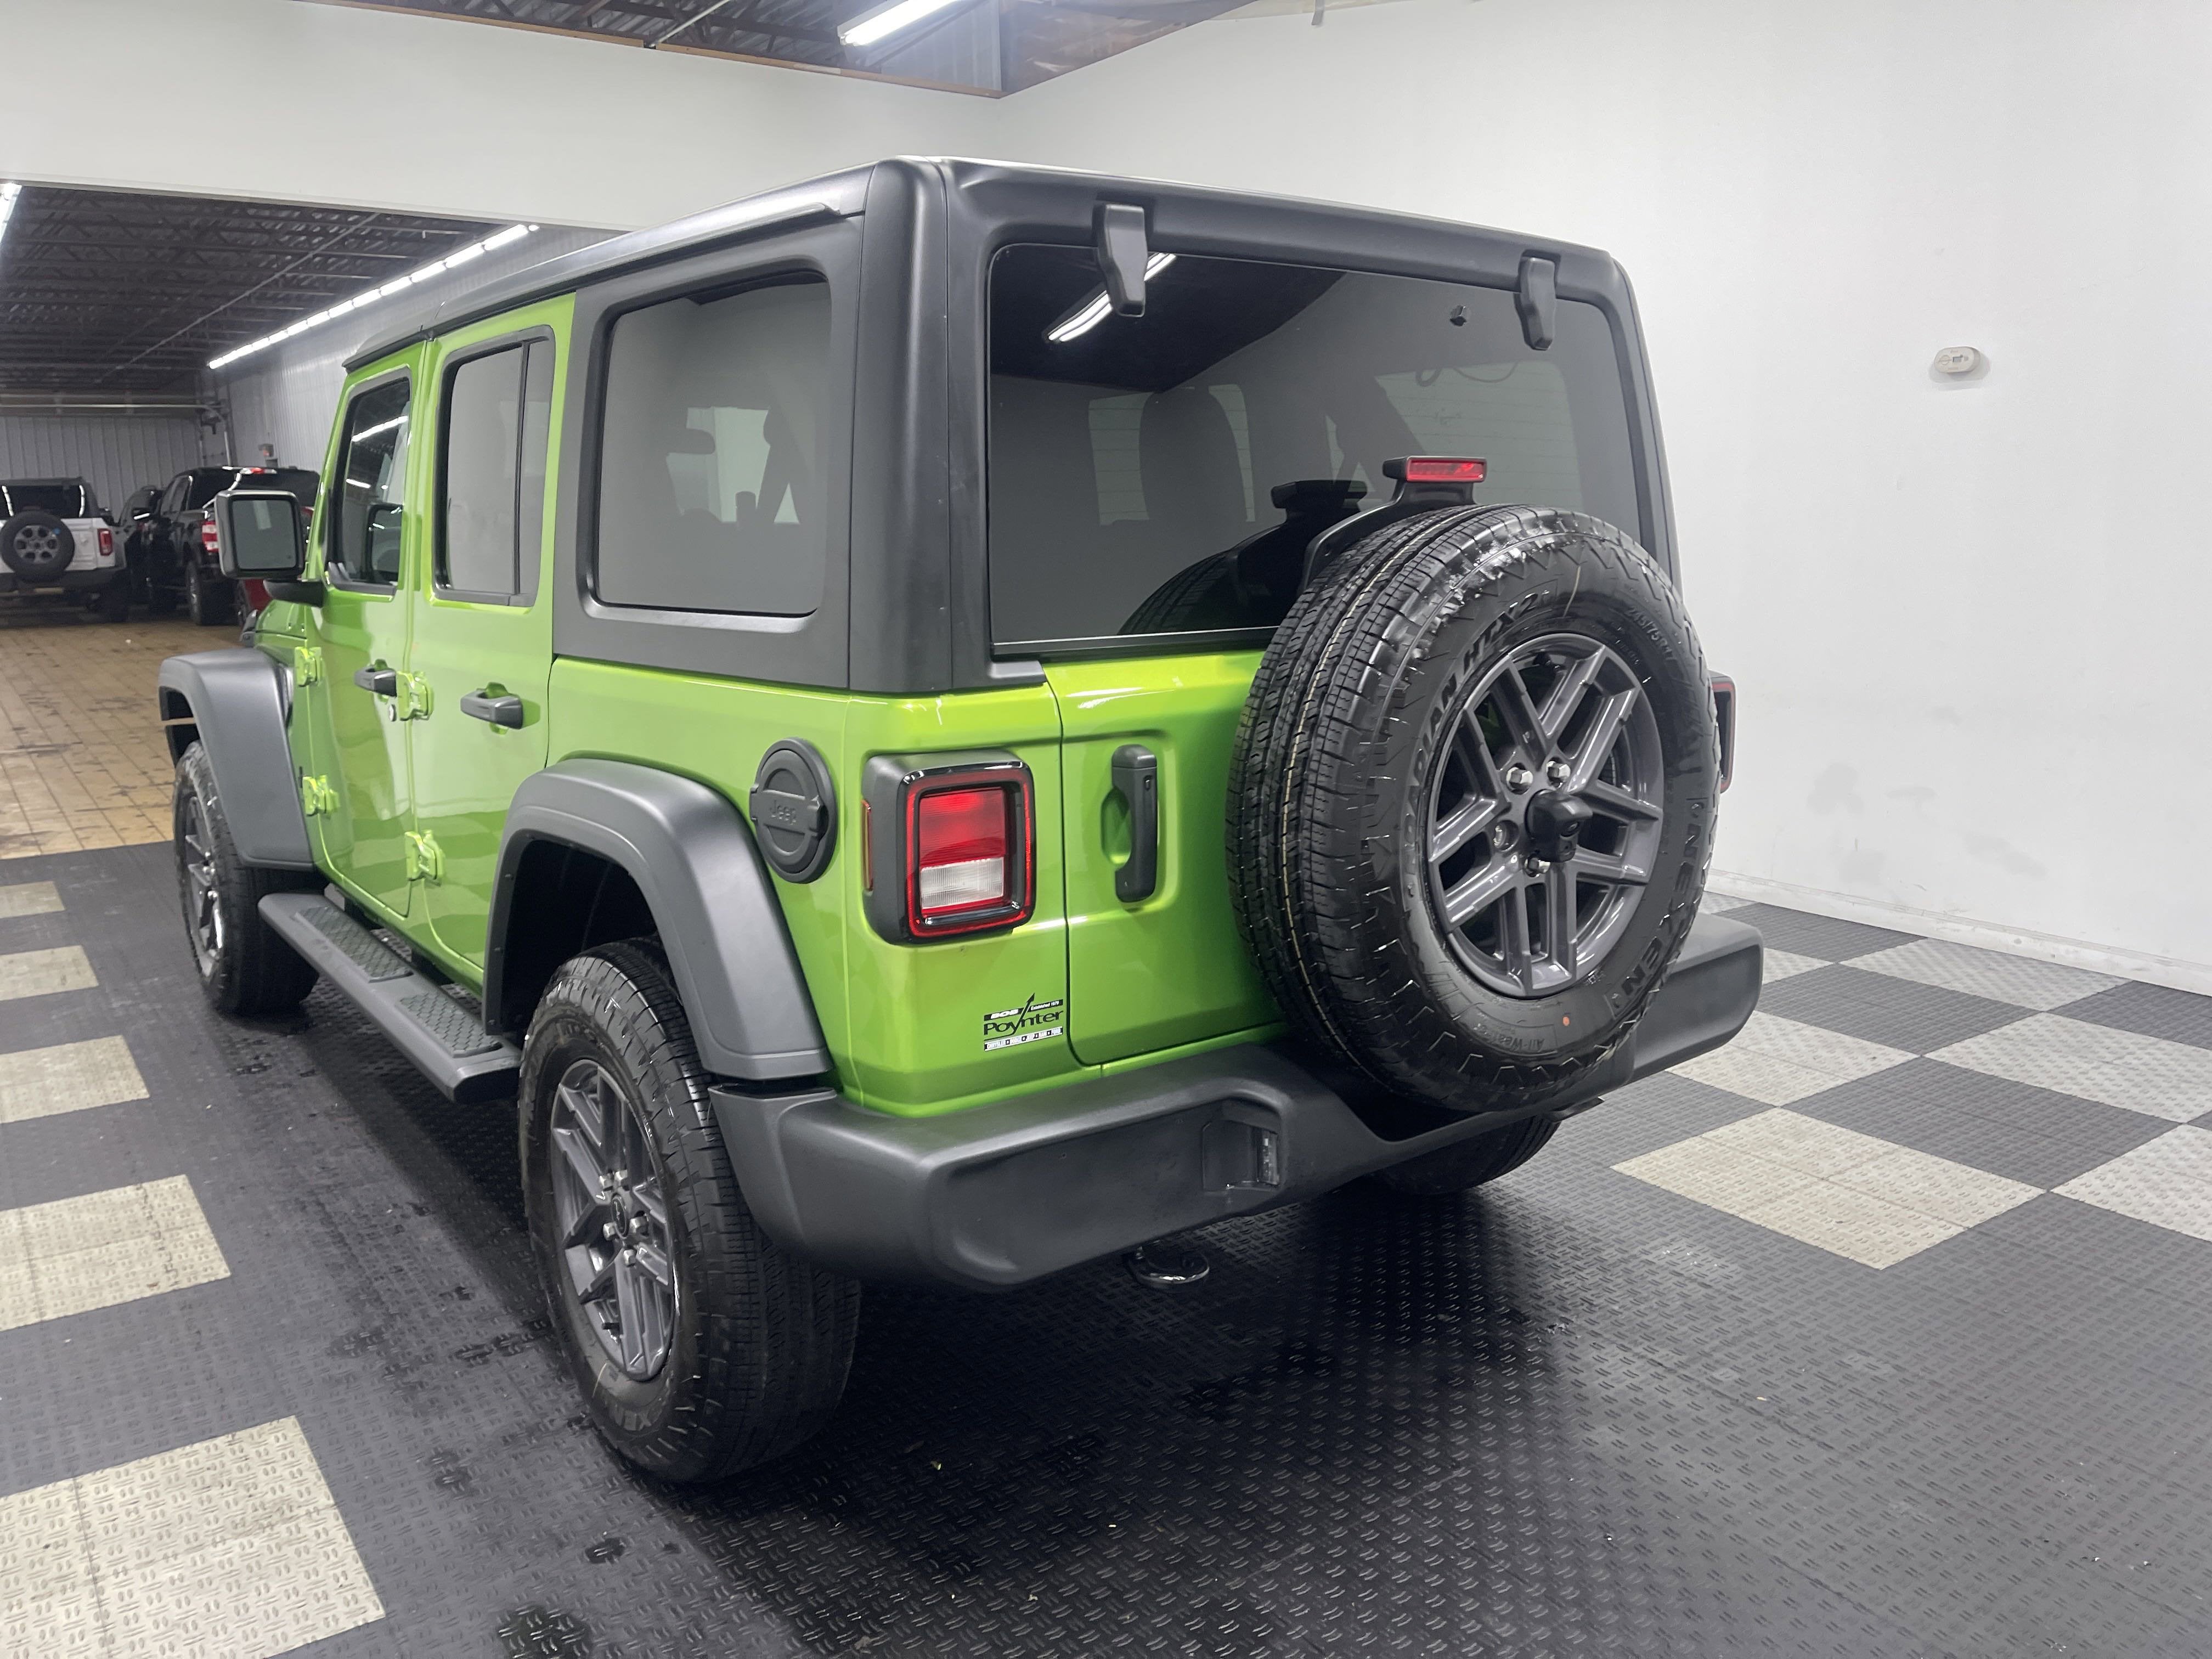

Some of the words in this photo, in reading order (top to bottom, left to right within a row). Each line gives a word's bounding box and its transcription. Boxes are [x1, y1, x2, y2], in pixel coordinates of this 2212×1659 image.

[769, 799, 797, 826] Jeep
[1621, 823, 1701, 996] NEXEN
[983, 1010, 1064, 1037] Poynter
